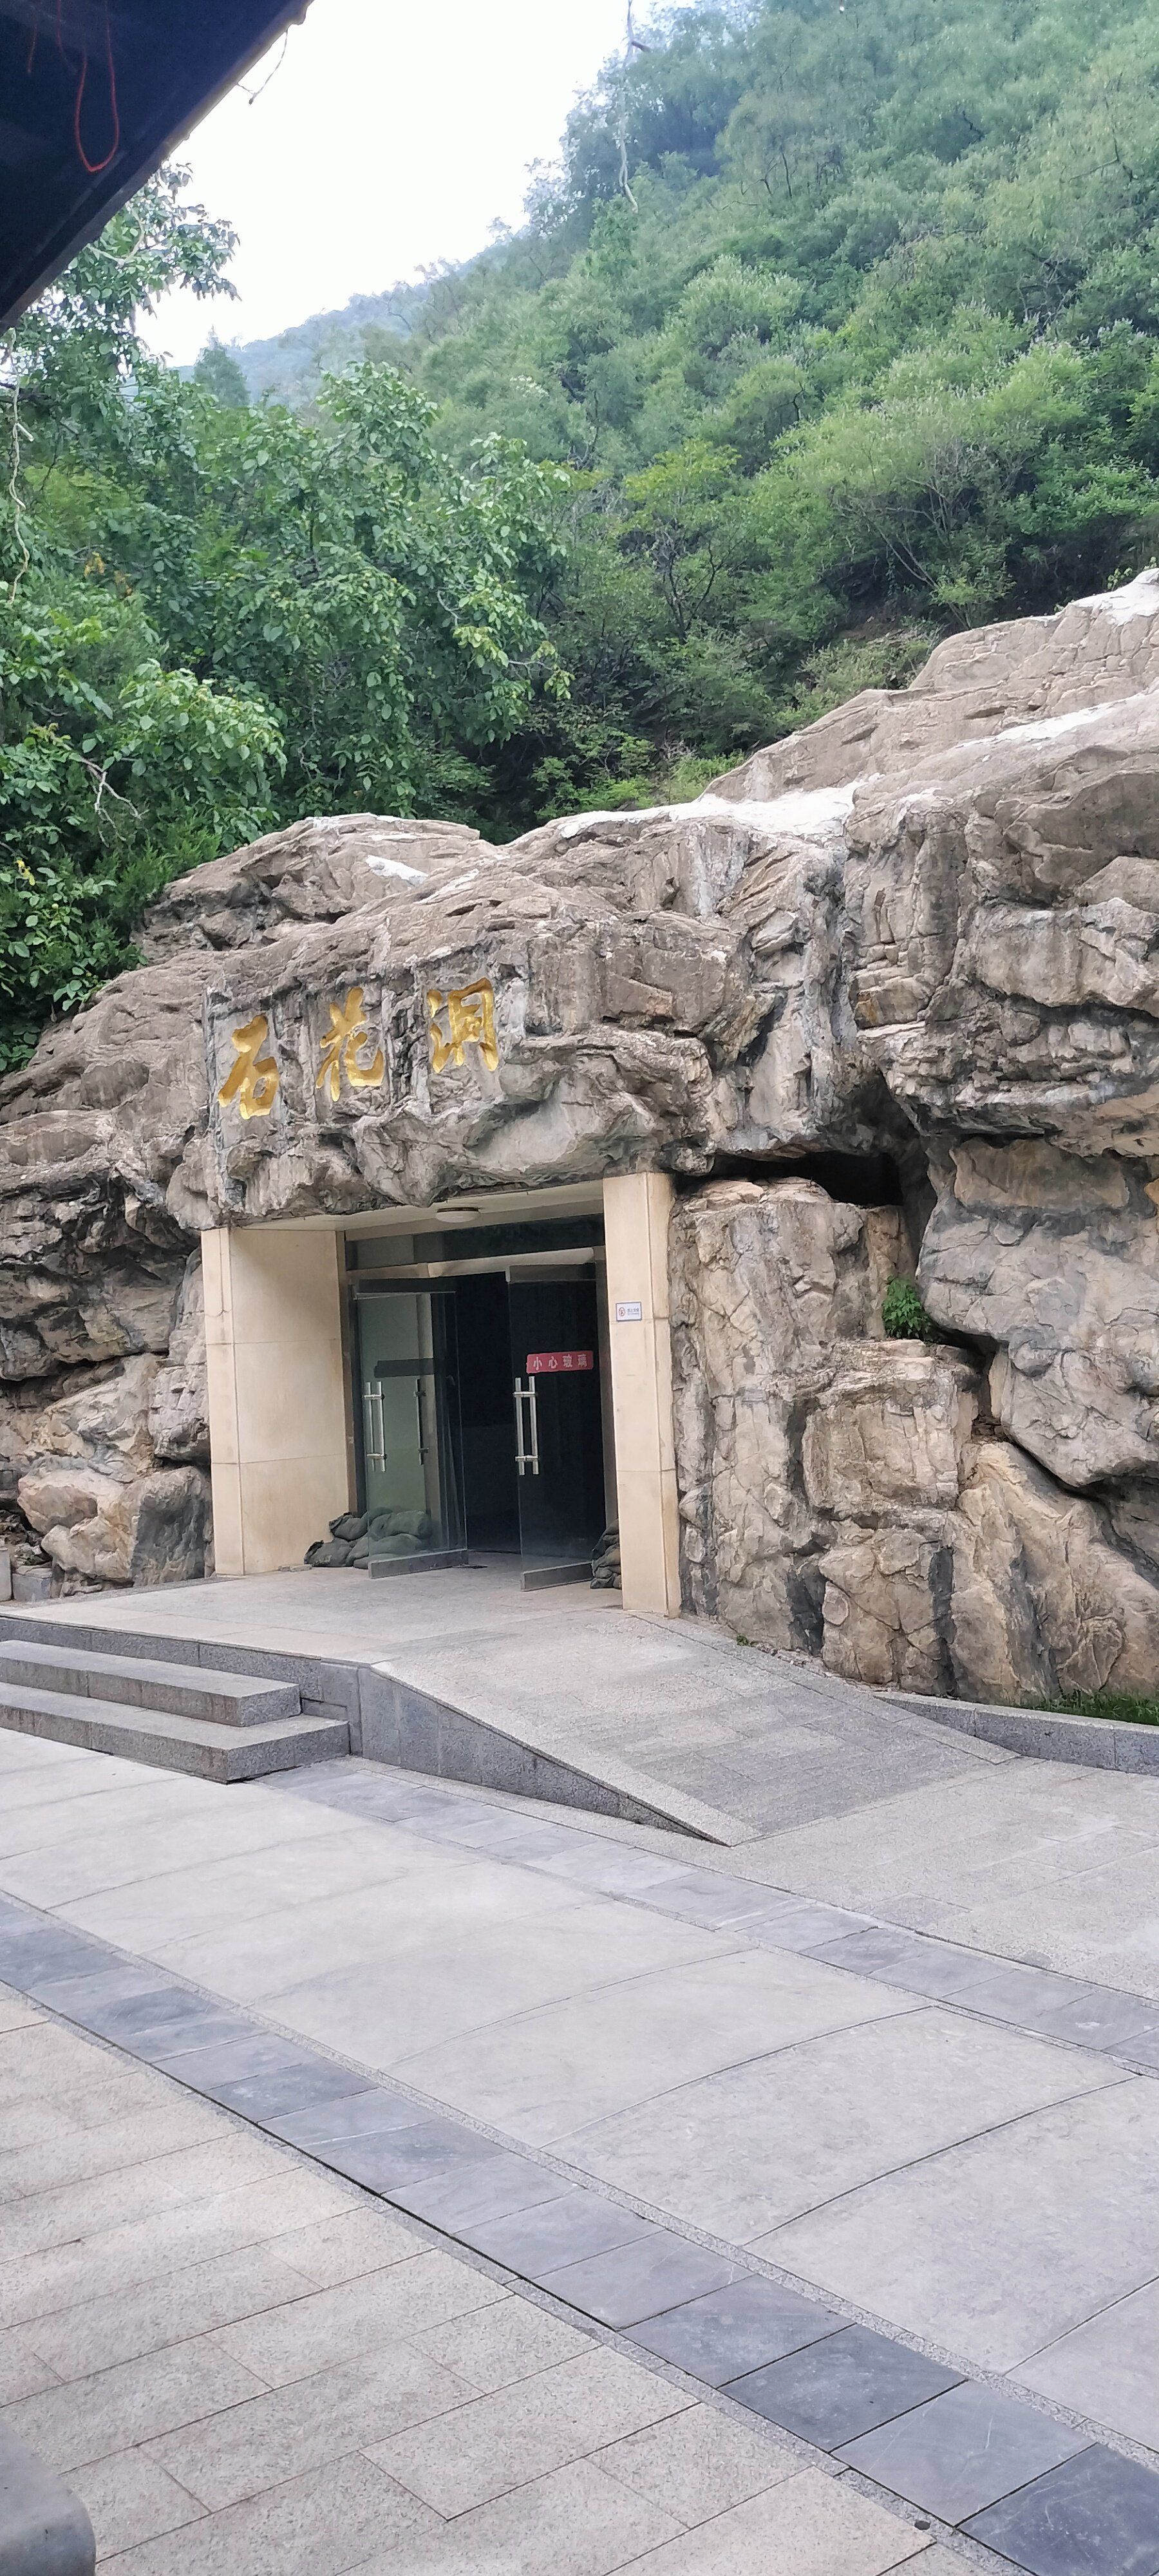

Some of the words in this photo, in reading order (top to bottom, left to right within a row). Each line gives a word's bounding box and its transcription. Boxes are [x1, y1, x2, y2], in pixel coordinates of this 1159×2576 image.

[218, 977, 499, 1119] 石花洞
[533, 1354, 588, 1370] 小心玻璃
